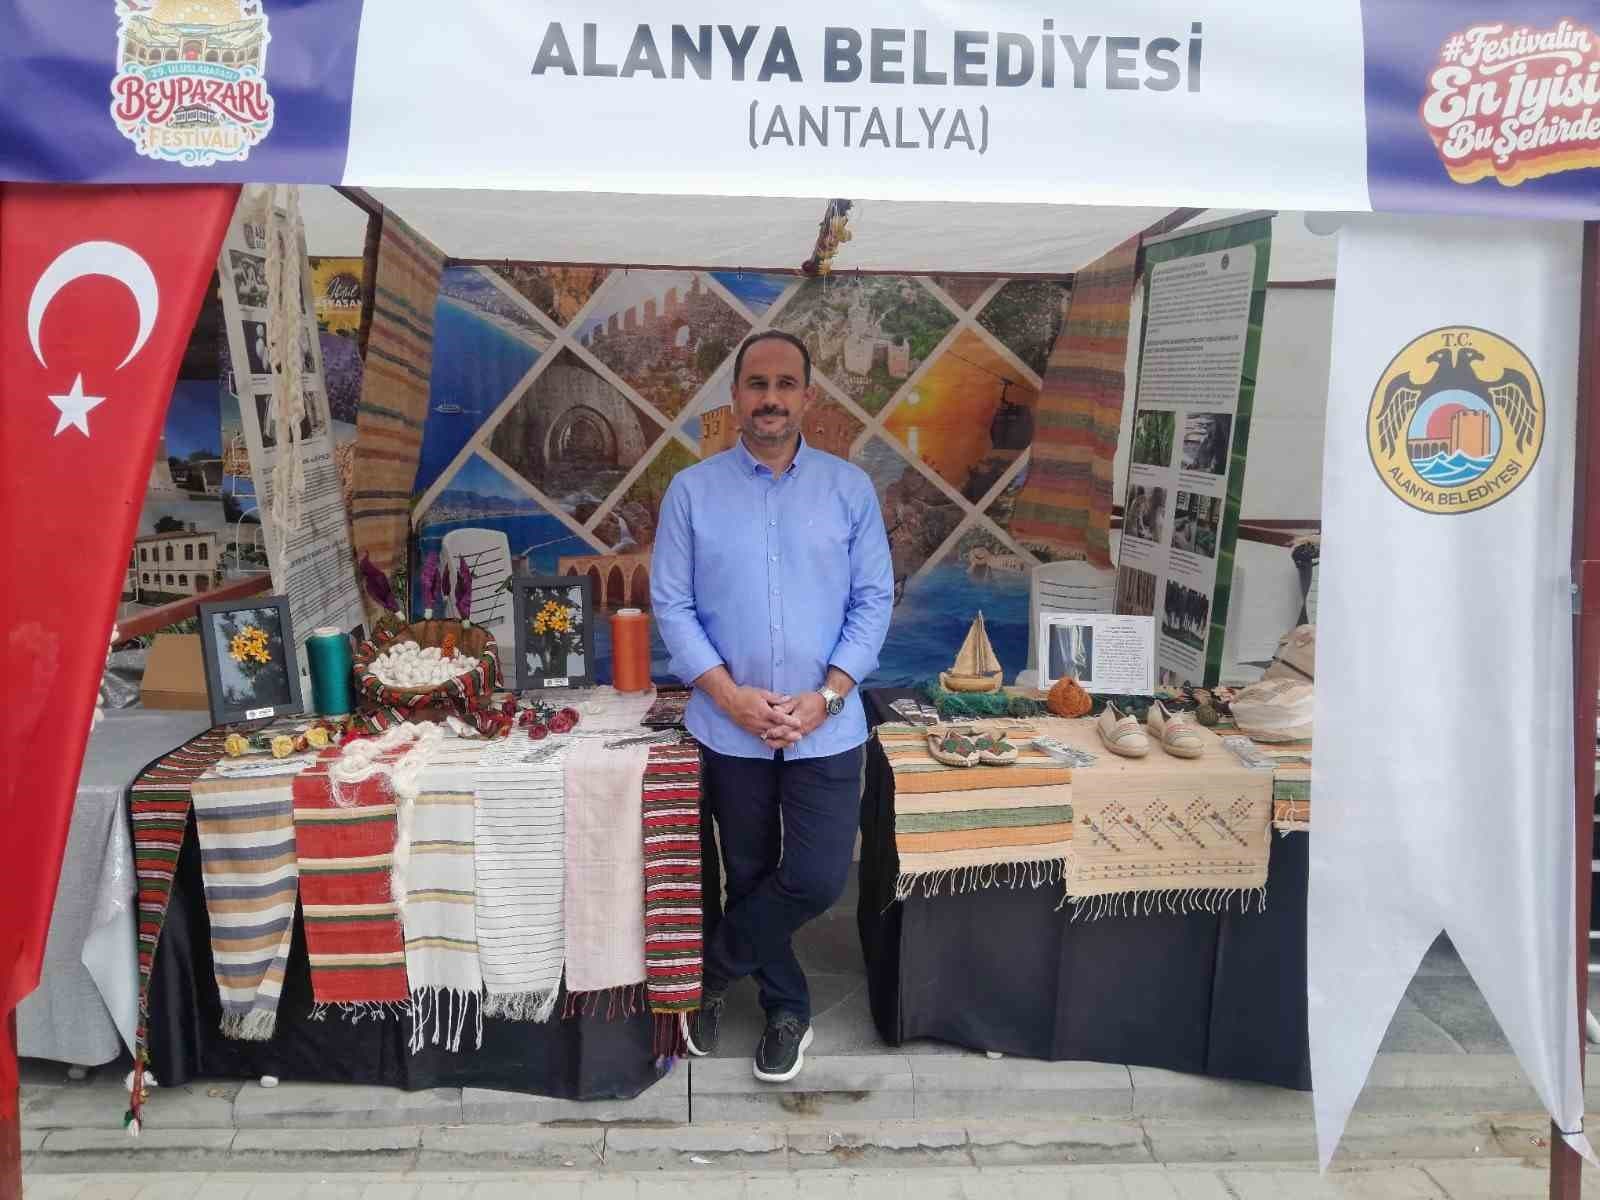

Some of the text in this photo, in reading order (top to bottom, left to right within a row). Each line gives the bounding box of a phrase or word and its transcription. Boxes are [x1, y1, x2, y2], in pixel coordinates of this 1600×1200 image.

[530, 18, 1204, 93] ALANYA BELEDİYESİ
[1443, 20, 1592, 68] #Festivalin
[116, 75, 270, 124] BEYPAZARI
[1424, 66, 1501, 128] En
[748, 99, 990, 155] (ANTALYA)
[1442, 108, 1600, 164] Bu Şehirde
[1442, 333, 1473, 347] T.C.
[1388, 458, 1523, 506] ALANYA BELEDİYESİ
